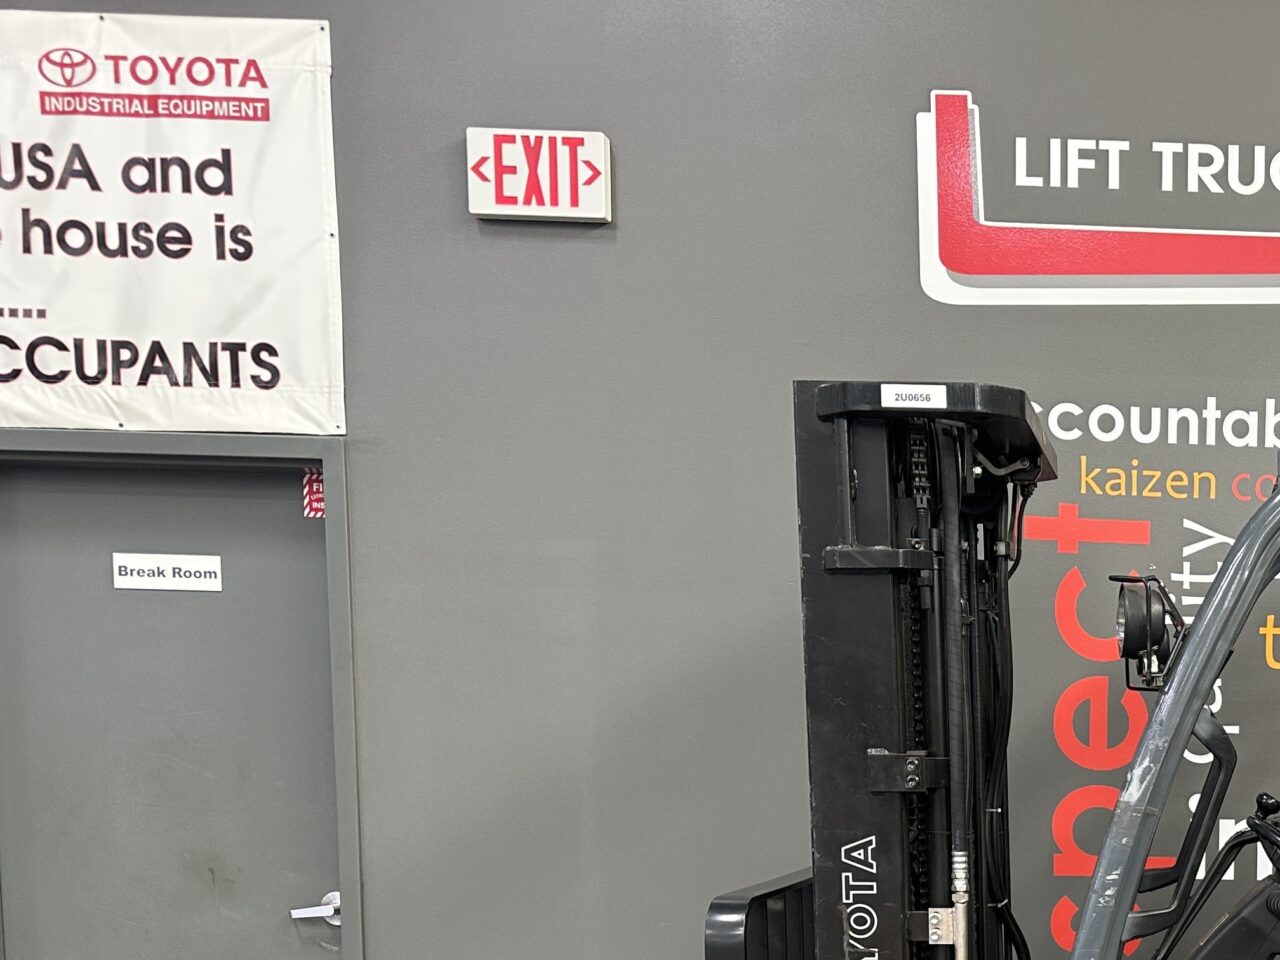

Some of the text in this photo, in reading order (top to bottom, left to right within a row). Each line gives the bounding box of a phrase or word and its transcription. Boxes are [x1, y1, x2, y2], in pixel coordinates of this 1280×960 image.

[104, 54, 269, 89] TOYOTA
[44, 95, 266, 118] INDUSTRIAL EQUIPMENT
[0, 142, 234, 196] USA and
[493, 134, 585, 208] EXIT
[1015, 136, 1130, 190] LIFT
[21, 207, 254, 262] house is
[894, 392, 932, 403] 2U0656
[1079, 455, 1217, 499] kaizen
[117, 565, 218, 580] Break Room
